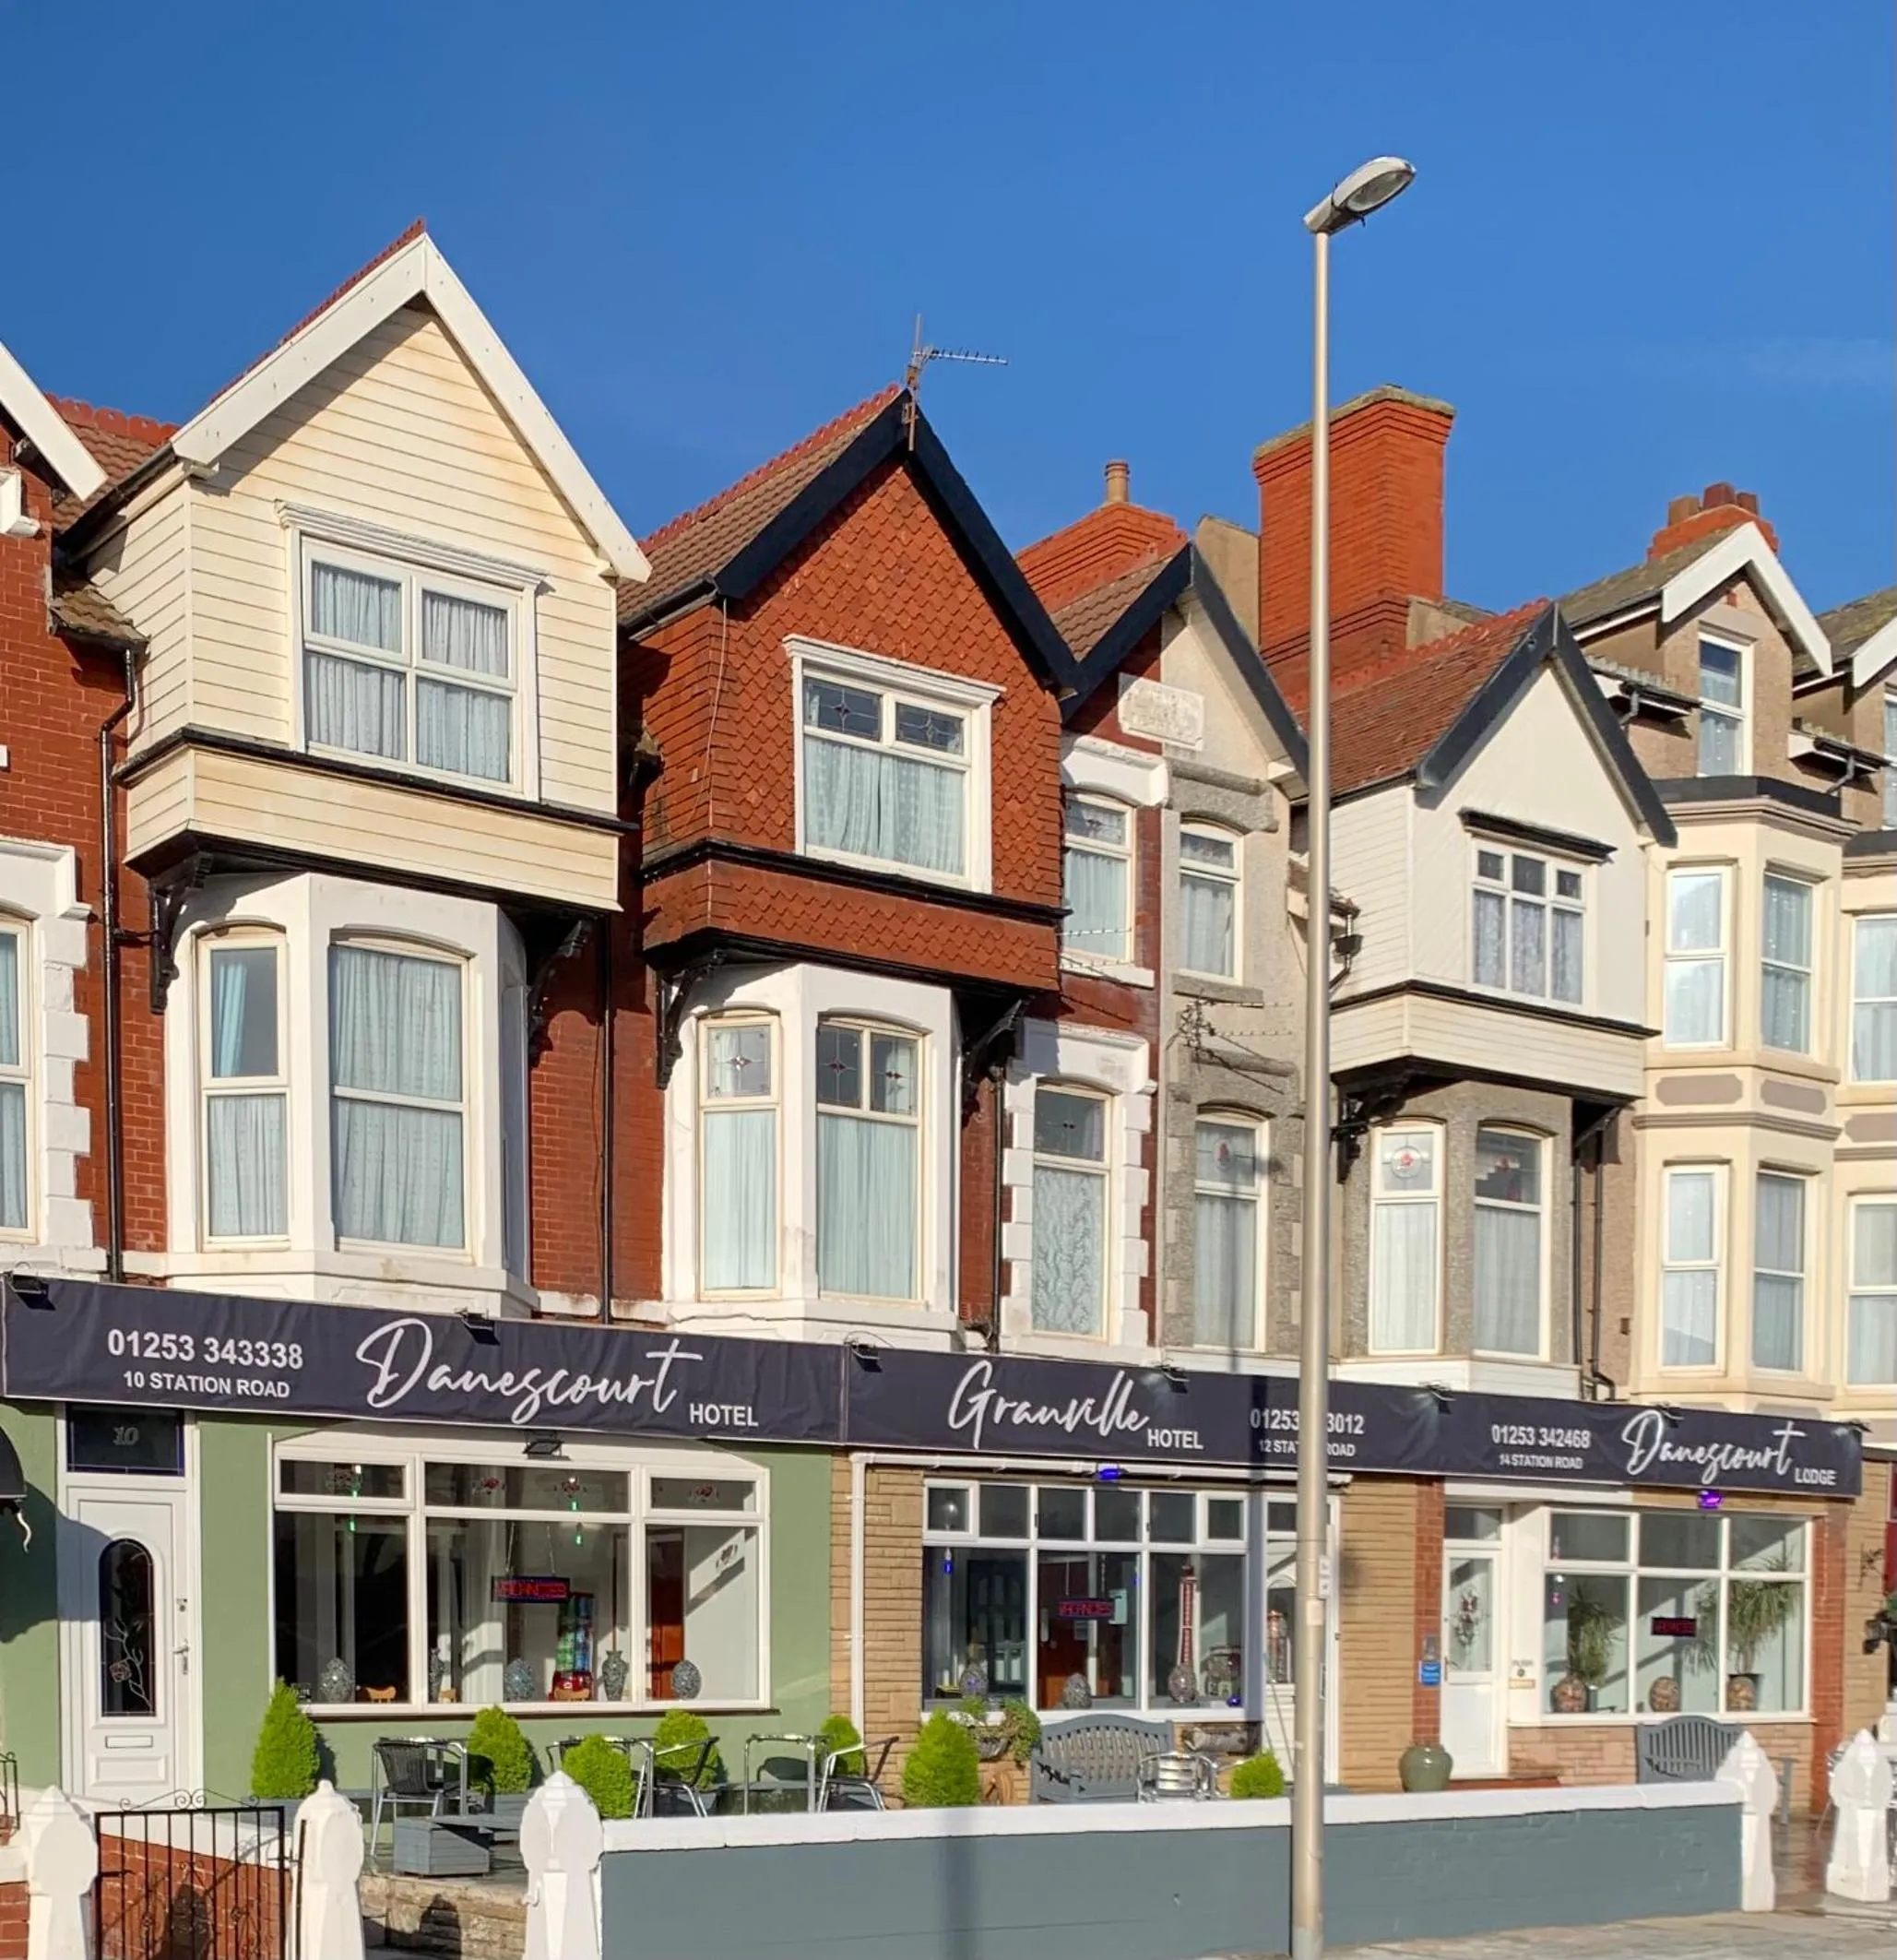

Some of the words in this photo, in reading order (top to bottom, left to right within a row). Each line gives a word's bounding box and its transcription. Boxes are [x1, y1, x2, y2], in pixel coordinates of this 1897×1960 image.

[108, 1328, 196, 1361] 01253
[204, 1336, 303, 1370] 343338
[355, 1317, 704, 1425] Danescourt
[689, 1403, 759, 1427] HOTEL
[123, 1372, 145, 1388] 10
[149, 1372, 231, 1395] STATION
[236, 1378, 290, 1398] ROAD
[947, 1359, 1150, 1450] Granville
[1147, 1428, 1203, 1450] HOTEL
[1250, 1408, 1299, 1431] 01253
[113, 1426, 139, 1445] 10
[1259, 1439, 1272, 1453] 12
[1491, 1424, 1535, 1446] 01253
[1538, 1427, 1592, 1449] 342468
[1620, 1408, 1808, 1485] Danescourt
[1795, 1467, 1837, 1486] LODGE
[1499, 1454, 1511, 1466] 14
[1511, 1454, 1554, 1468] STATION
[1554, 1455, 1584, 1469] ROAD
